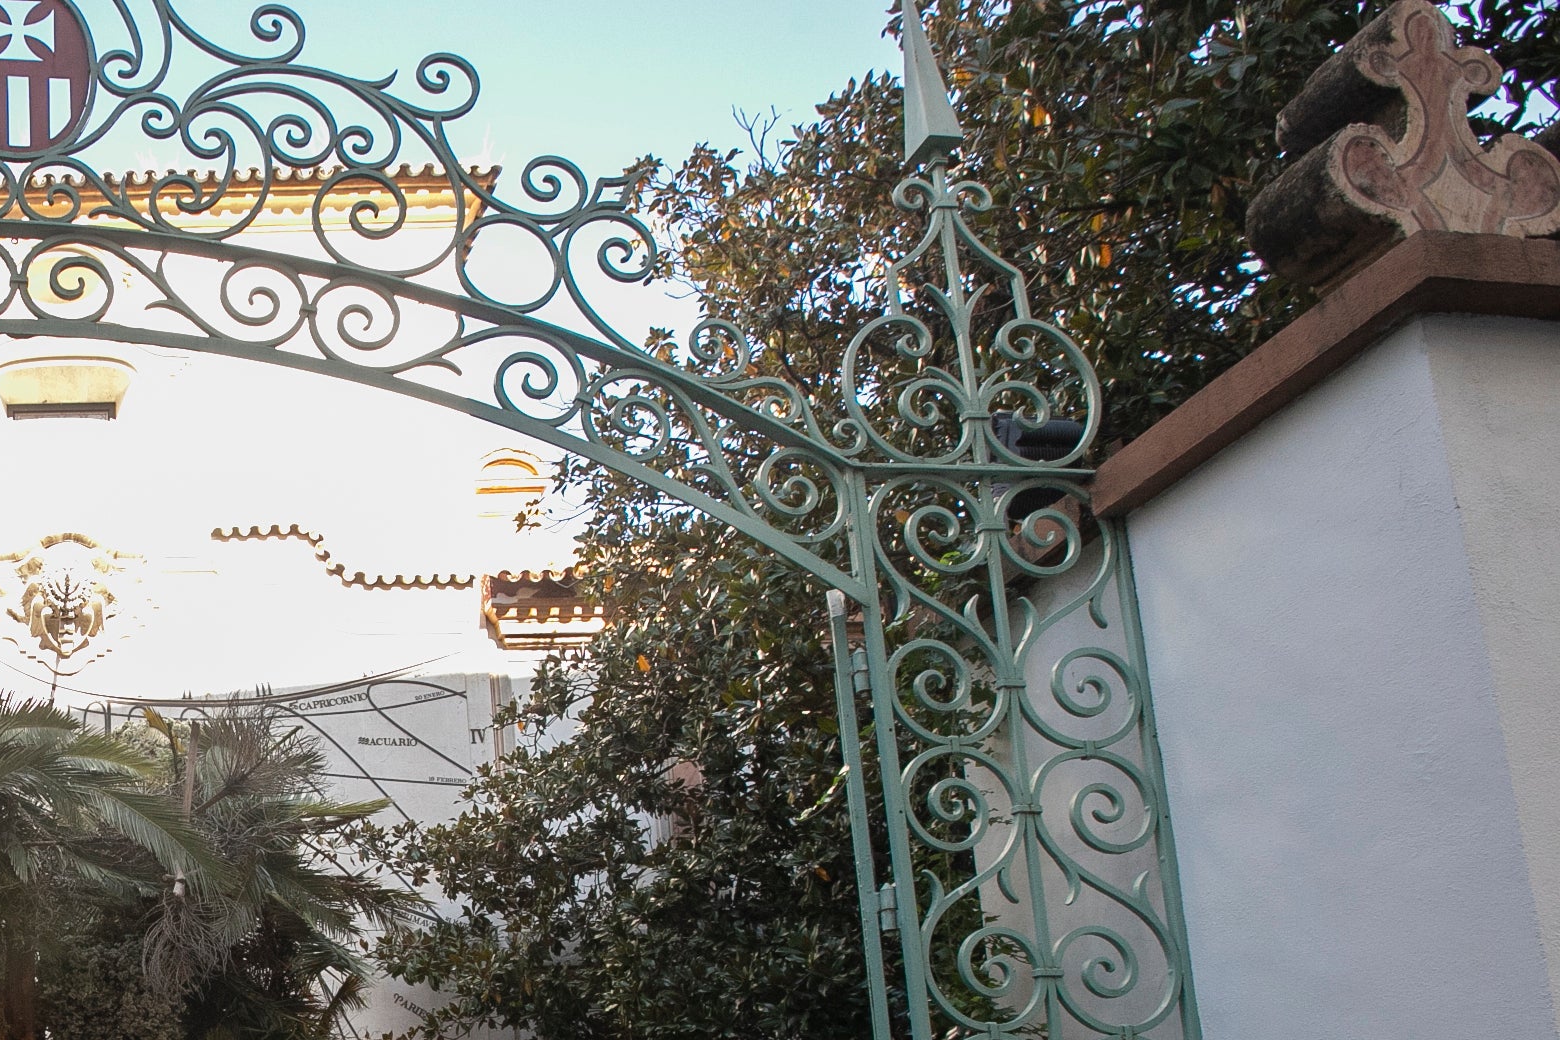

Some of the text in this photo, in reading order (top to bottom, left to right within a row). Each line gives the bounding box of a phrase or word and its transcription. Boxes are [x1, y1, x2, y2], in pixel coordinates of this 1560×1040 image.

[299, 692, 368, 711] CAPRICORNIO
[367, 737, 418, 747] ACUARIO
[470, 728, 487, 744] IV
